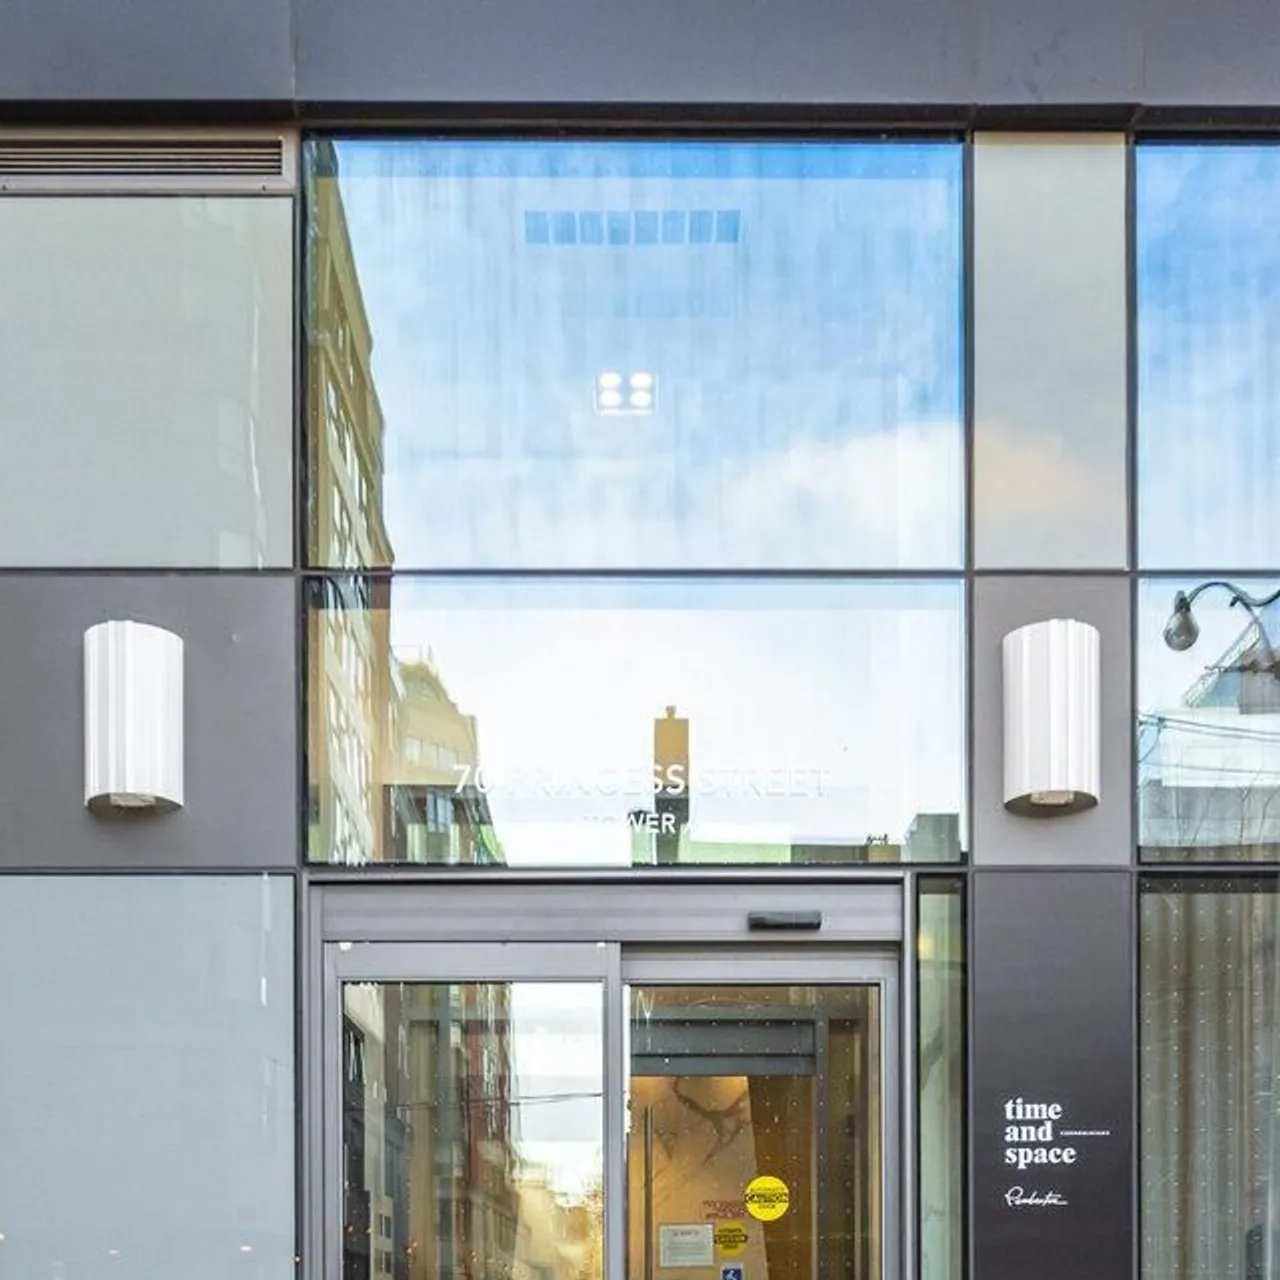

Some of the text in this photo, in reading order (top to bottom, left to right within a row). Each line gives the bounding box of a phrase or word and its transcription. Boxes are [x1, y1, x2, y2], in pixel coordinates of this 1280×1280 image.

[452, 763, 492, 794] 70
[700, 767, 832, 798] STREET
[1004, 1097, 1063, 1120] time
[1004, 1121, 1054, 1142] and
[1004, 1146, 1077, 1169] space
